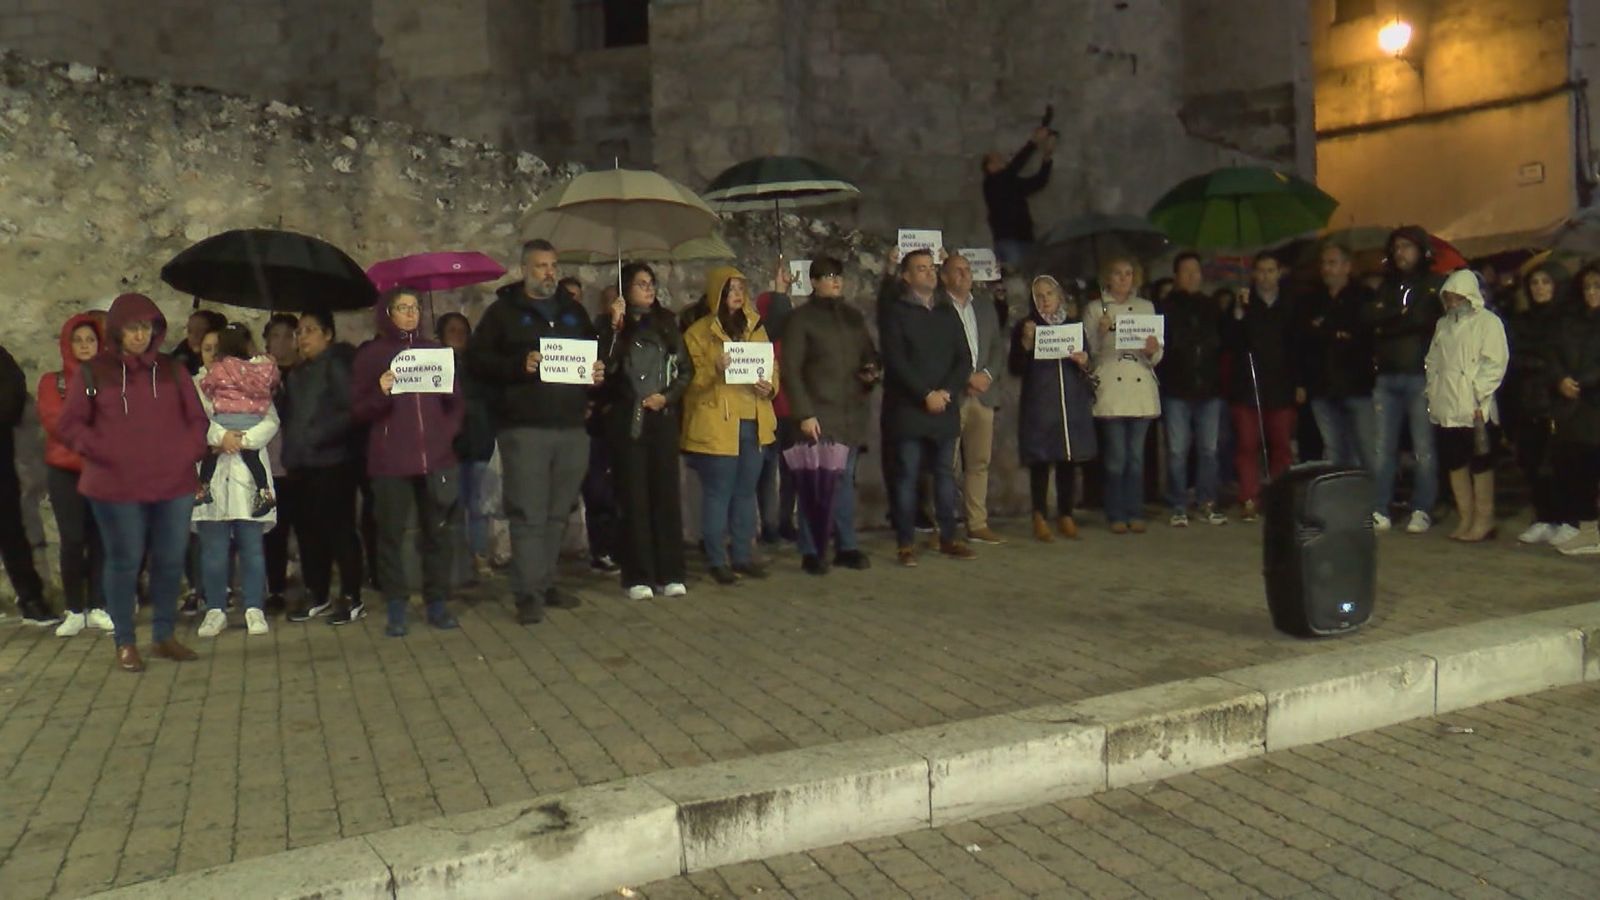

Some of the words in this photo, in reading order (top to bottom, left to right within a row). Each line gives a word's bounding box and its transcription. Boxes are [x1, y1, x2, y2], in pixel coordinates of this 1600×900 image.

[544, 343, 563, 351] ¡NOS
[395, 354, 416, 363] ¡NOS
[544, 354, 586, 362] QUEREMOS
[395, 364, 442, 374] QUEREMOS
[394, 376, 422, 384] VIVAS!
